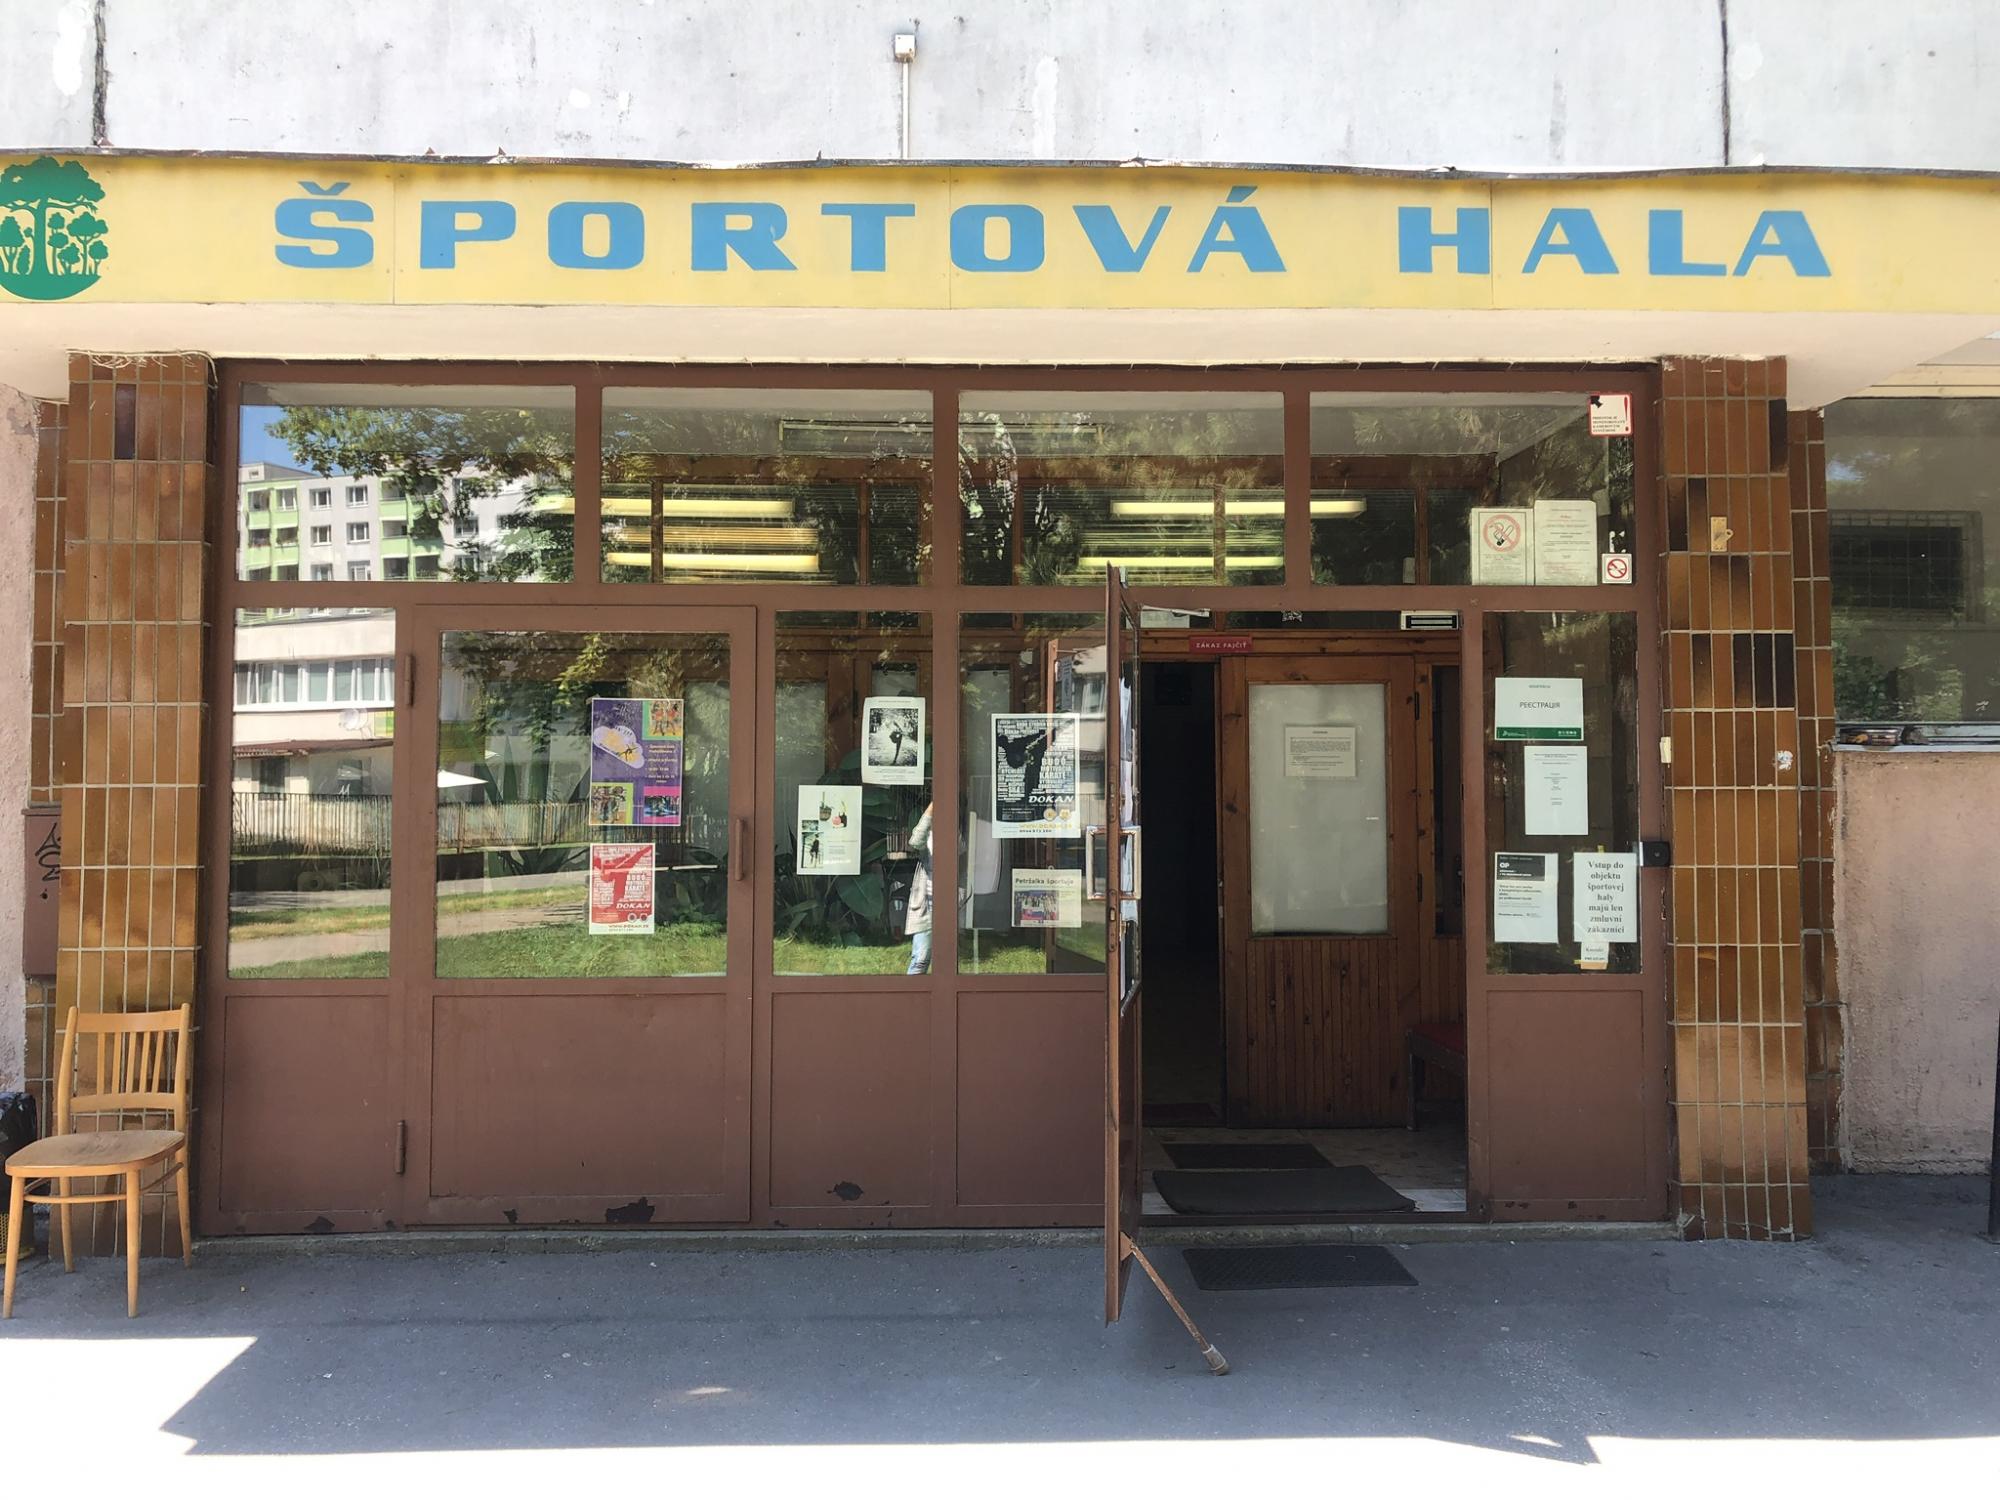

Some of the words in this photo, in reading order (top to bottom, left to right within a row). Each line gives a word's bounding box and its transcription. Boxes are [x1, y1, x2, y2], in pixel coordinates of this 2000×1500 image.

[276, 183, 1283, 272] ŠPORTOVÁ
[1400, 207, 1829, 276] HALA
[1196, 641, 1221, 649] ZÁKAZ
[1588, 861, 1611, 870] Vstup
[1613, 861, 1624, 869] do
[1590, 872, 1621, 881] objektu
[1587, 884, 1624, 892] športovej
[1597, 893, 1613, 902] haly
[1588, 904, 1609, 913] majú
[1590, 914, 1622, 923] zmluvní
[1587, 925, 1625, 933] zákazníci
